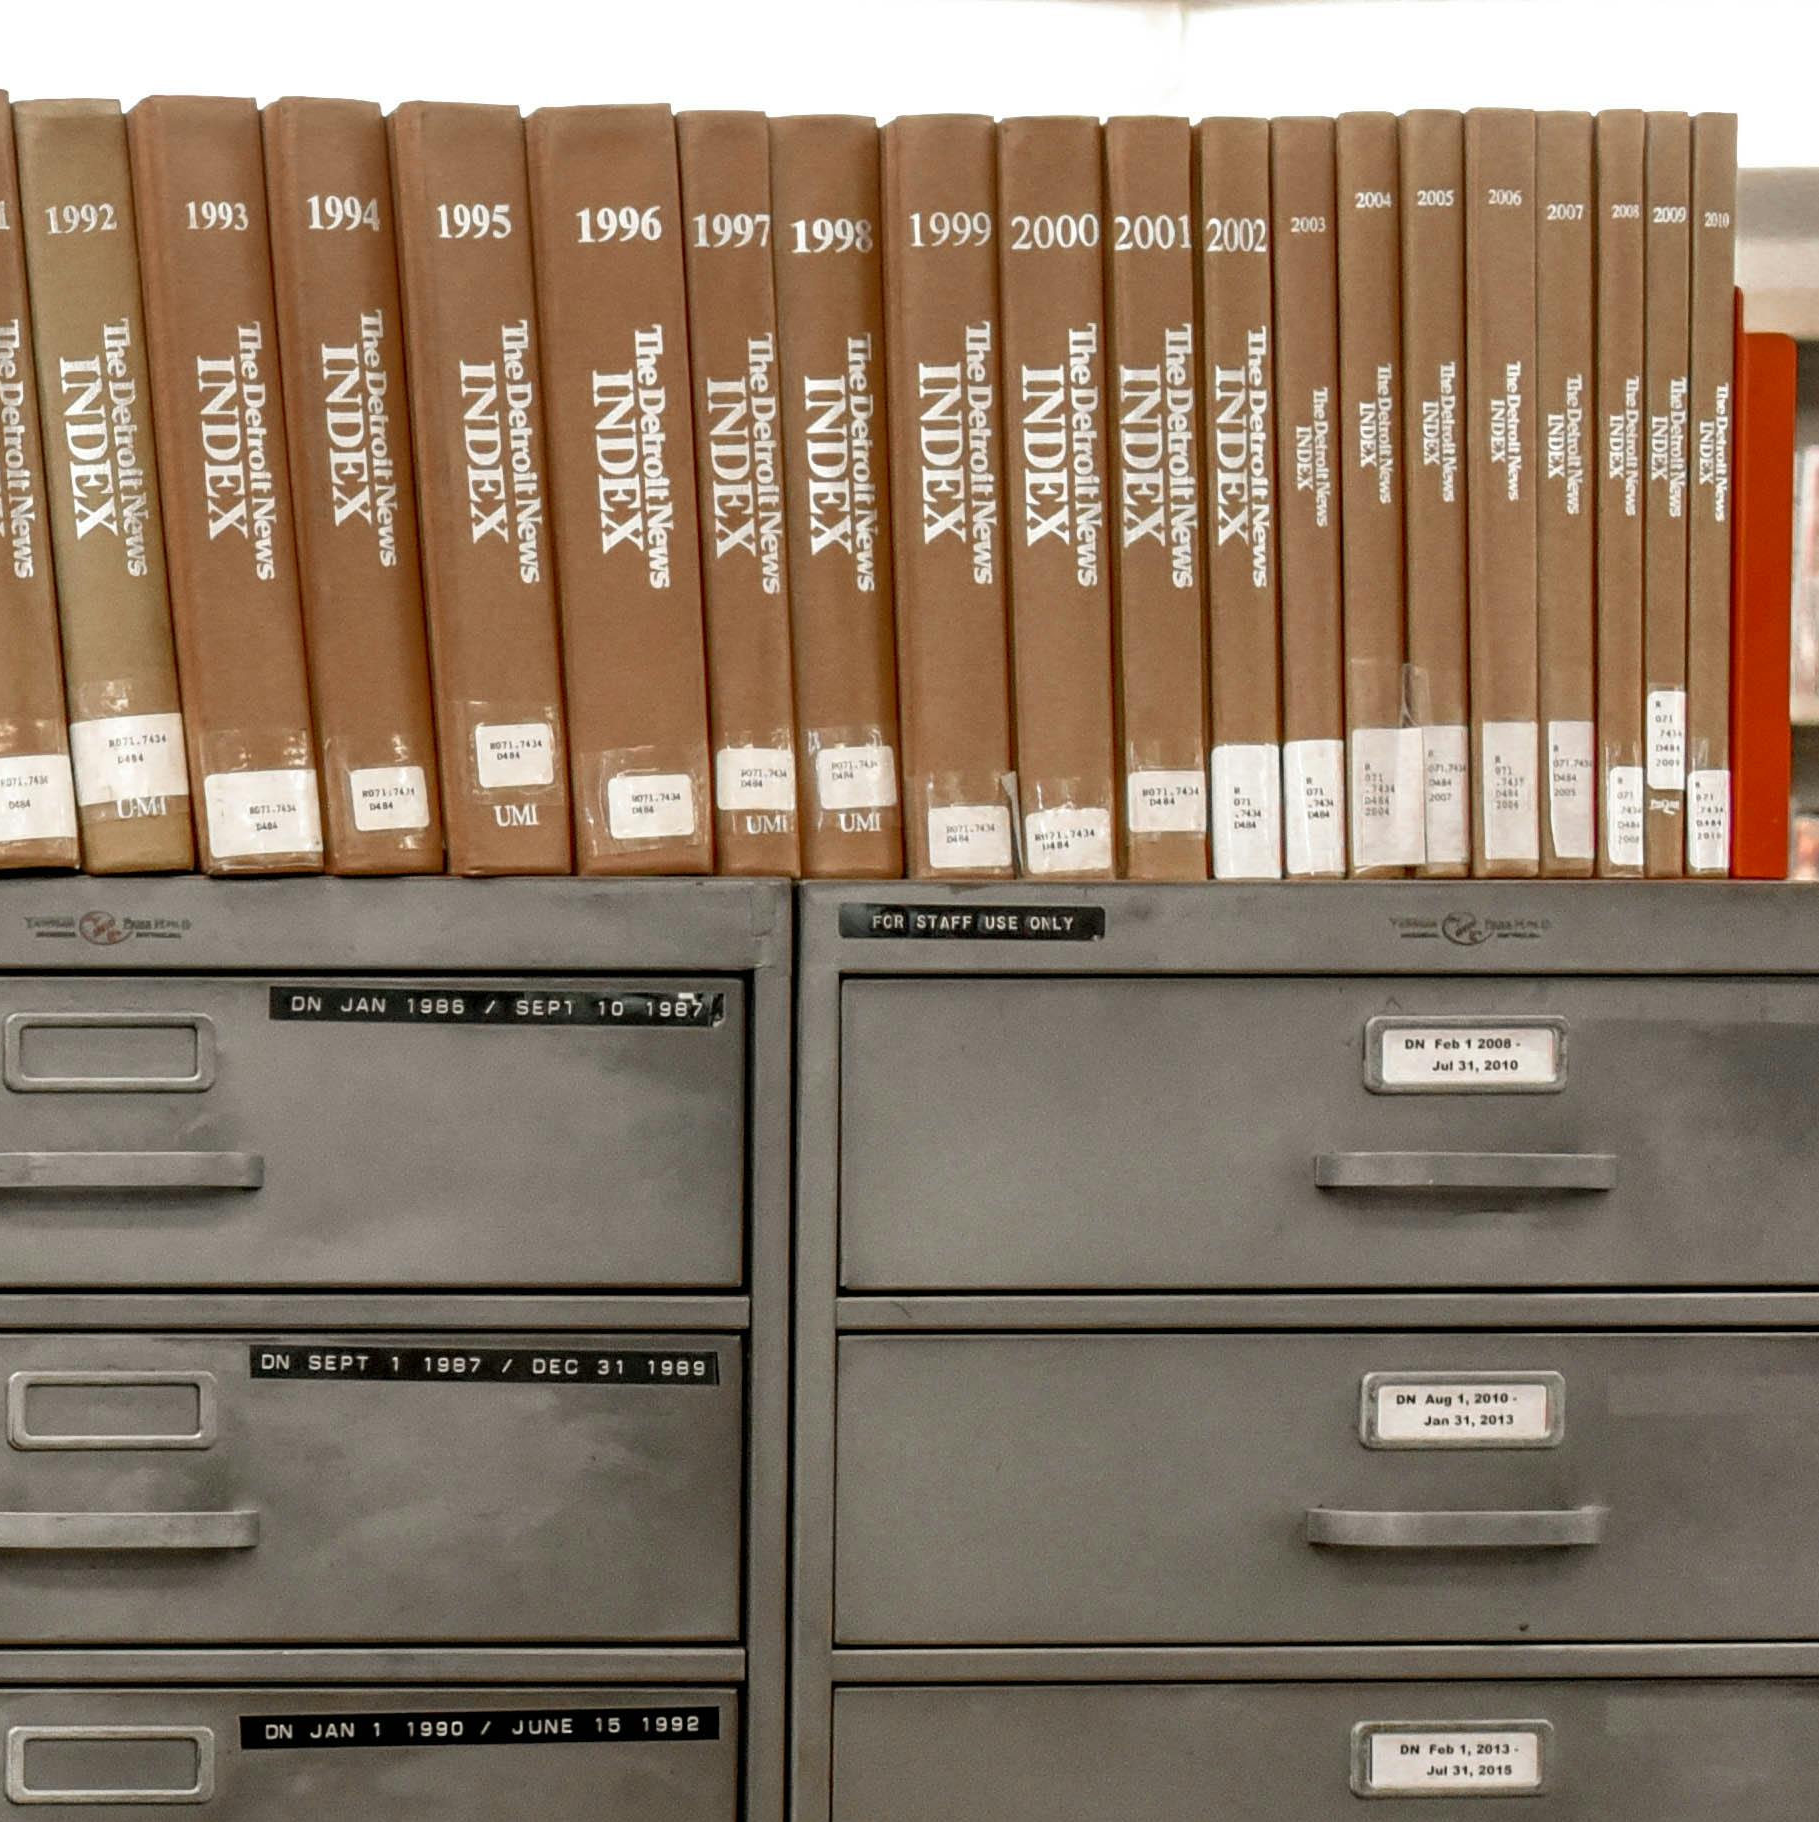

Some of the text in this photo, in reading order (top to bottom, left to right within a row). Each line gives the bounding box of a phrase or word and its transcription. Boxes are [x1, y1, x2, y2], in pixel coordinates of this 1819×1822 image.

[307, 195, 379, 231] 1994
[1417, 189, 1454, 207] 2005
[1488, 188, 1522, 206] 2006
[45, 203, 117, 234] 1992
[187, 201, 249, 231] 1993
[437, 203, 512, 239] 1995
[576, 205, 662, 243] 1996
[910, 211, 991, 247] 1999
[1011, 213, 1099, 250] 2000
[1114, 214, 1191, 251] 2001
[1206, 217, 1267, 253] 2002
[592, 369, 644, 554] INDEX
[1021, 364, 1070, 547] INDEX
[872, 914, 1074, 931] FOR STAFF USE ONLY
[1404, 1038, 1425, 1050] DN
[1434, 1038, 1460, 1050] Feb
[1477, 1037, 1512, 1050] 2008
[1432, 1059, 1519, 1073] Jul 31, 2010
